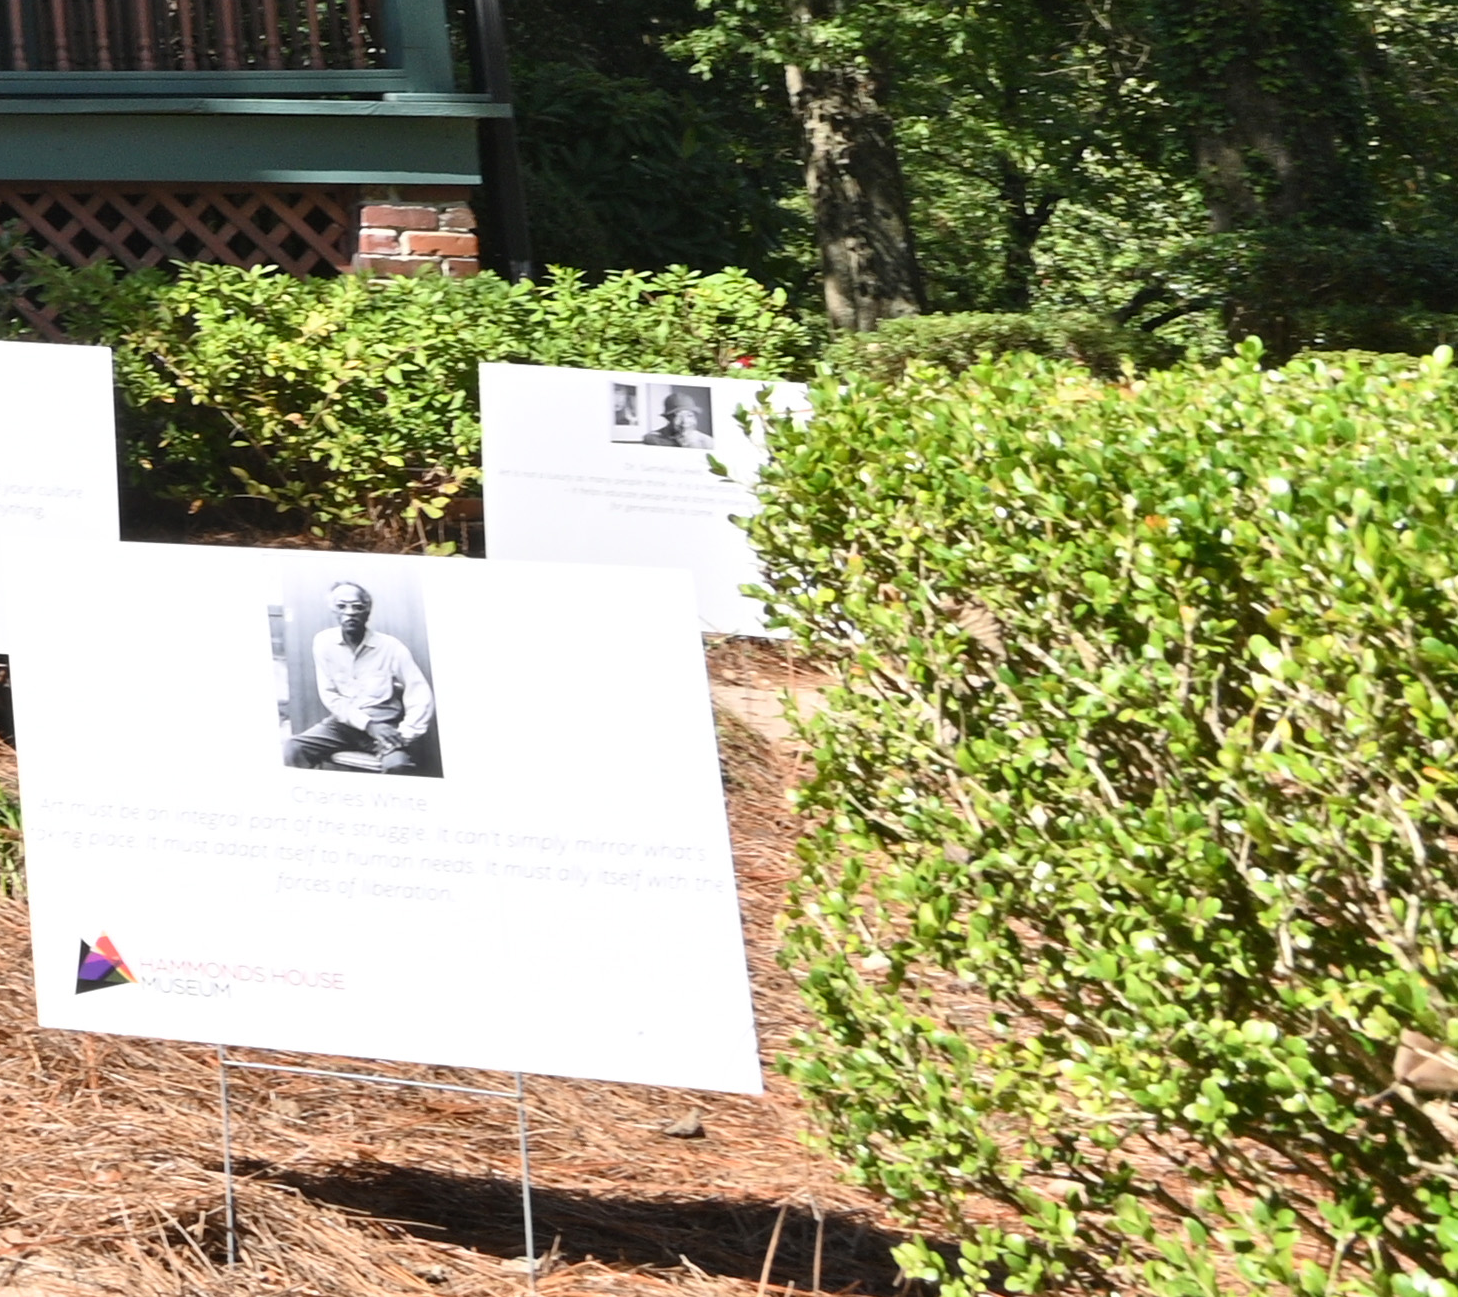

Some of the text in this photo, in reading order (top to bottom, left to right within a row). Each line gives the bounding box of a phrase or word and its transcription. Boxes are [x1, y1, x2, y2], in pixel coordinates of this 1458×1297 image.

[291, 785, 427, 812] Charles White
[40, 792, 64, 812] Art
[70, 796, 114, 816] must
[119, 798, 140, 818] be
[146, 805, 168, 820] an
[176, 803, 242, 832] integral
[249, 810, 287, 836] part
[293, 812, 313, 838] of
[317, 813, 346, 834] the
[436, 823, 449, 842] It
[507, 828, 568, 857] simply
[575, 835, 637, 856] mirror
[147, 831, 157, 850] It
[163, 834, 208, 854] must
[214, 836, 267, 864] adapt
[275, 841, 316, 868] itself
[321, 846, 339, 864] to
[345, 846, 412, 869] human
[485, 857, 498, 876] It
[503, 860, 551, 880] must
[557, 862, 590, 889] ally
[598, 865, 642, 893] itself
[648, 869, 687, 890] with
[695, 873, 725, 894] the
[275, 872, 331, 900] forces
[336, 876, 357, 902] of
[140, 957, 345, 991] HAMMONDS HOUSE
[141, 976, 231, 997] MUSEUM
